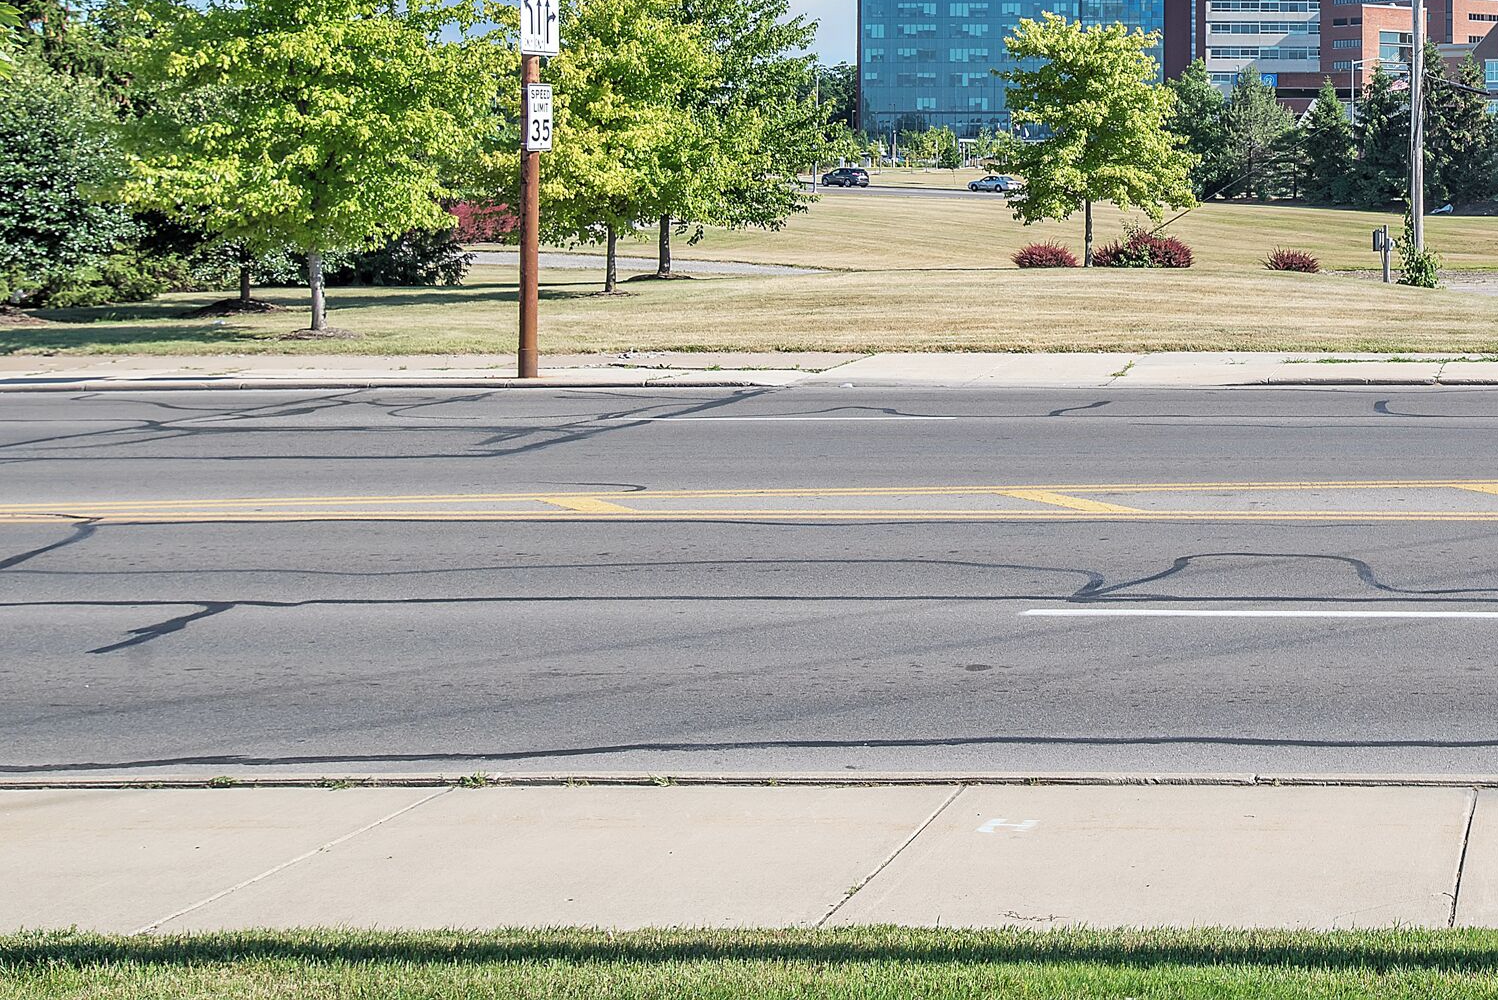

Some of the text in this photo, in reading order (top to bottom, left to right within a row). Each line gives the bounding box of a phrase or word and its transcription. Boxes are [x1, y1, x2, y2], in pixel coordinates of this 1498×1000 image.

[531, 89, 550, 100] SPEED
[533, 103, 549, 113] LIMIT
[531, 119, 550, 142] 35
